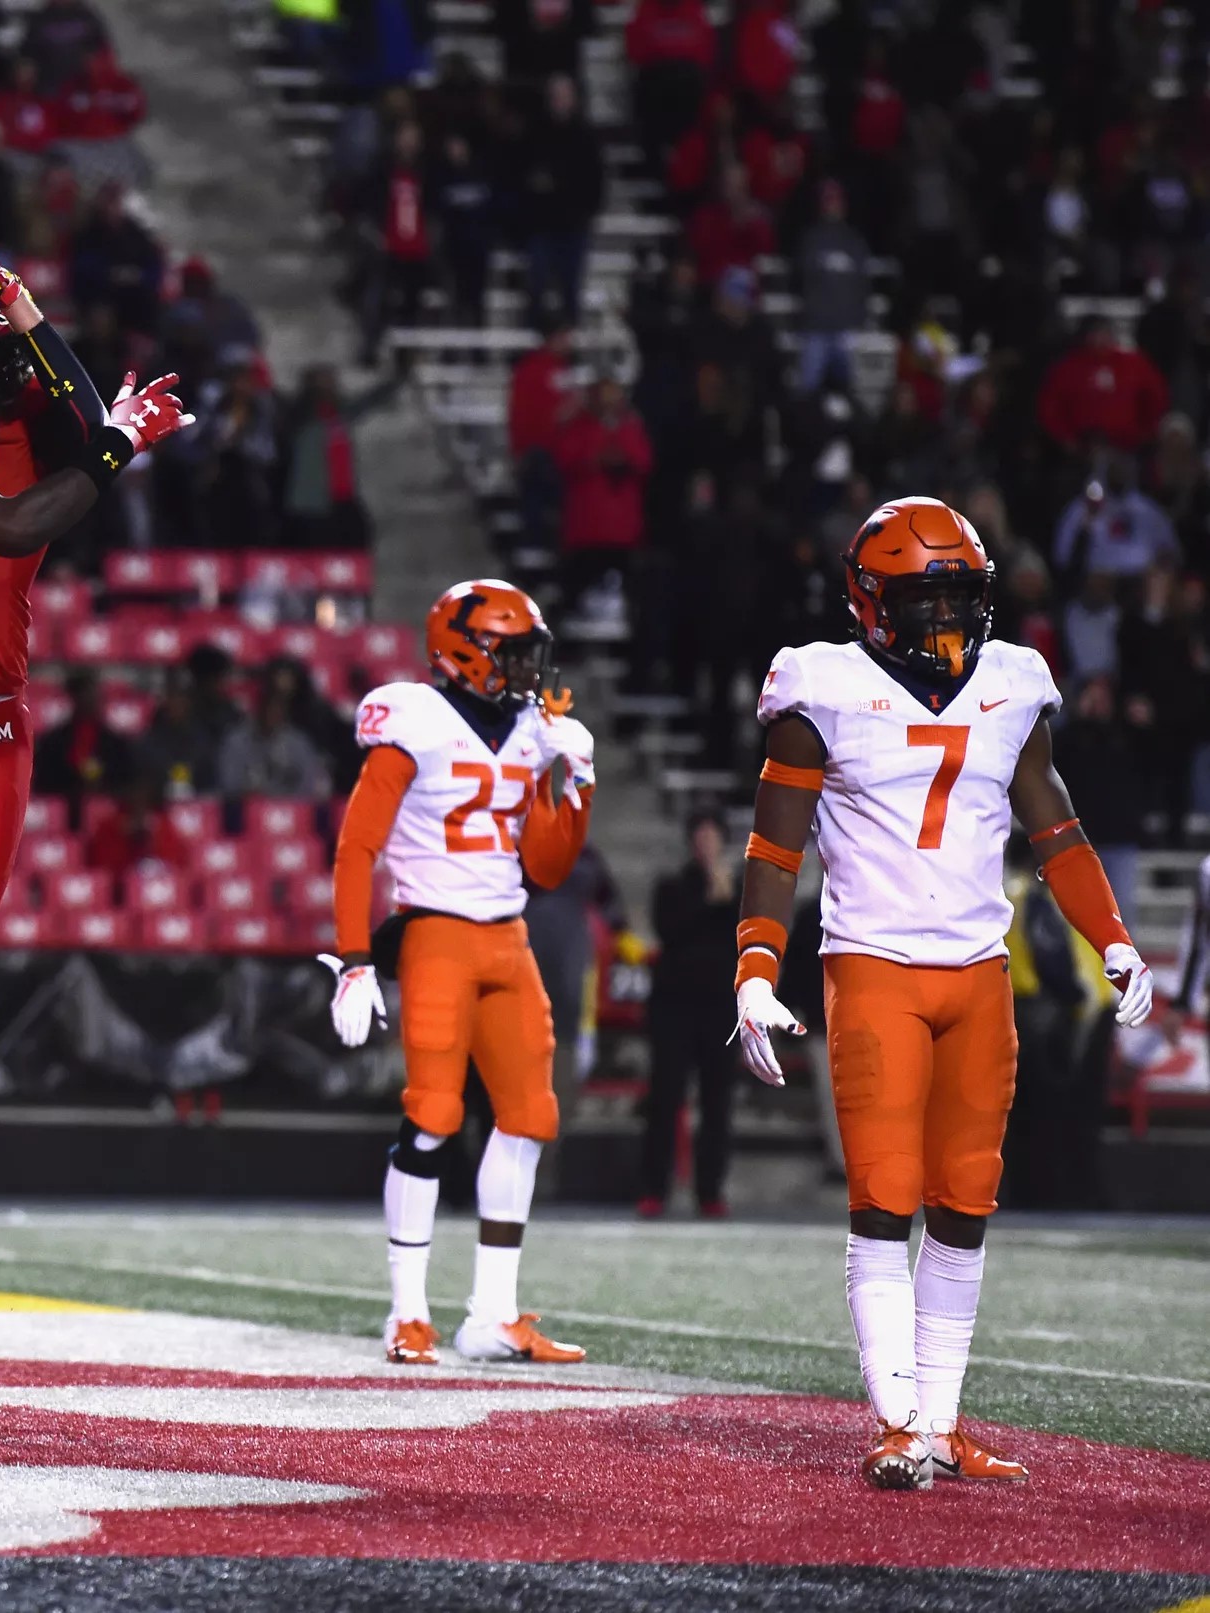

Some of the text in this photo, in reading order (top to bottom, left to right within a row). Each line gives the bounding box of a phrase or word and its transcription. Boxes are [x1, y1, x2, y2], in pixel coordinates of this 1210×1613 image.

[359, 704, 390, 735] 22
[444, 762, 534, 854] 22
[907, 725, 971, 849] 7
